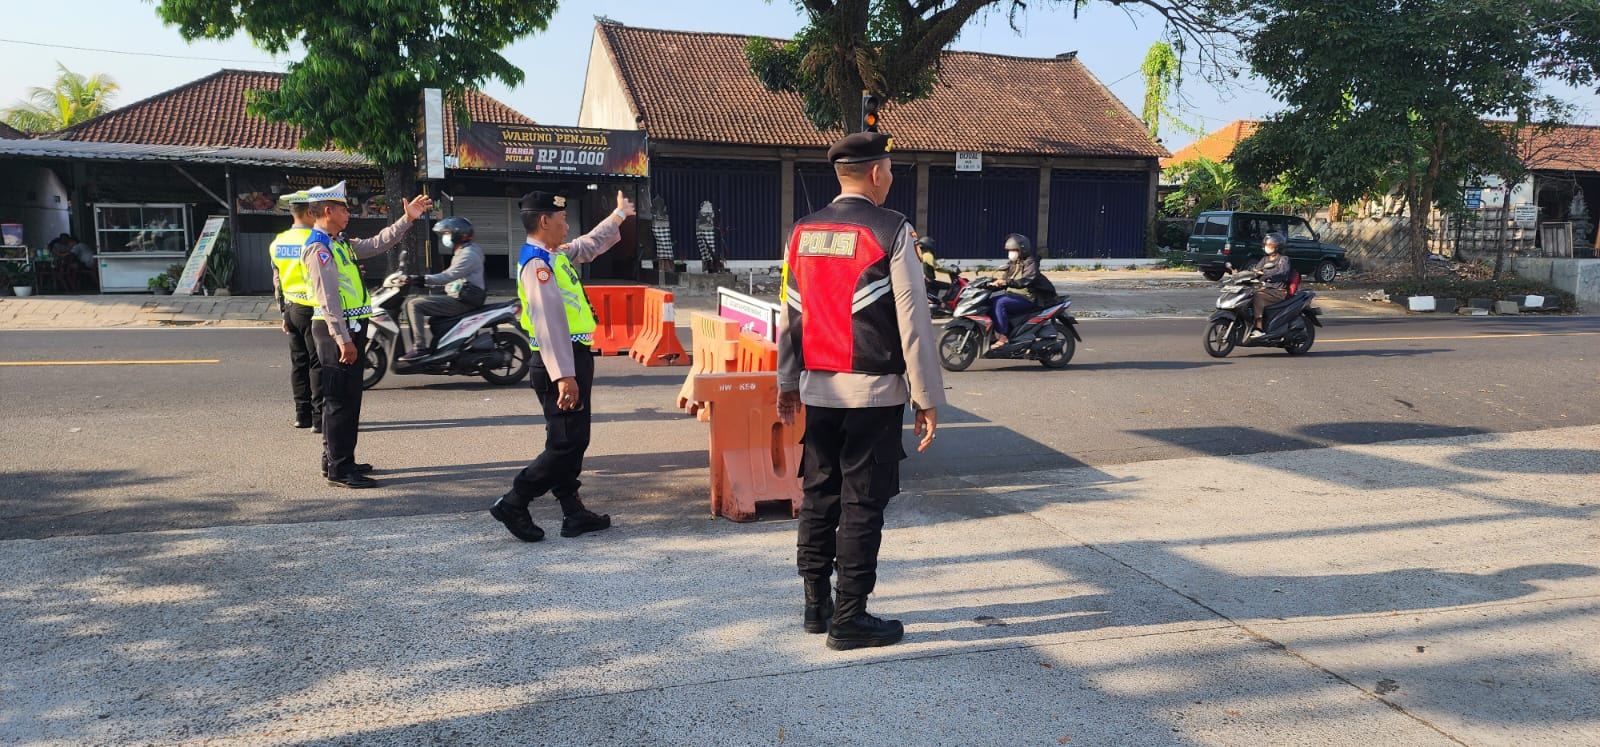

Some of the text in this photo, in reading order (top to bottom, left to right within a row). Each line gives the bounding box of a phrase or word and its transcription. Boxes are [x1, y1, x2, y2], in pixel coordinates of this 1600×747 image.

[502, 131, 608, 146] WARUNG PENJARA
[505, 147, 605, 166] HARGA RP 10.000
[505, 155, 533, 163] MULAI
[798, 231, 857, 256] POLISI
[276, 246, 301, 257] POLISI
